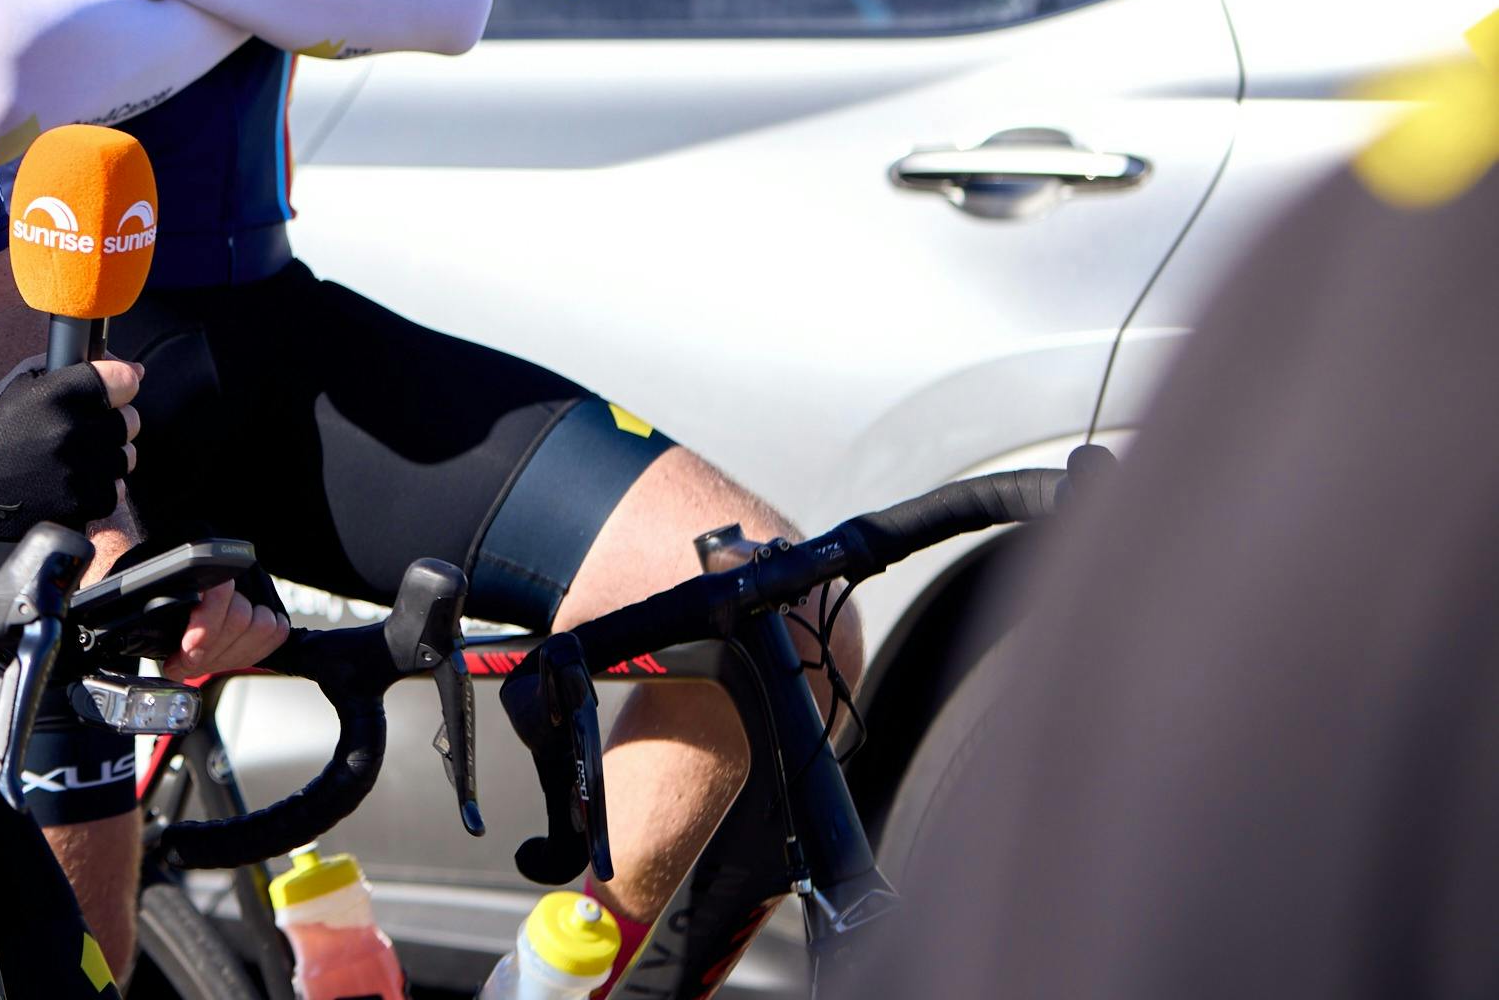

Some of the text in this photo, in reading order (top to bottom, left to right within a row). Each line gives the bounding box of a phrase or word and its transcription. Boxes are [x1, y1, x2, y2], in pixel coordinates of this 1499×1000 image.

[13, 220, 95, 254] sunrise
[103, 224, 157, 254] sunris
[21, 752, 136, 794] XUS
